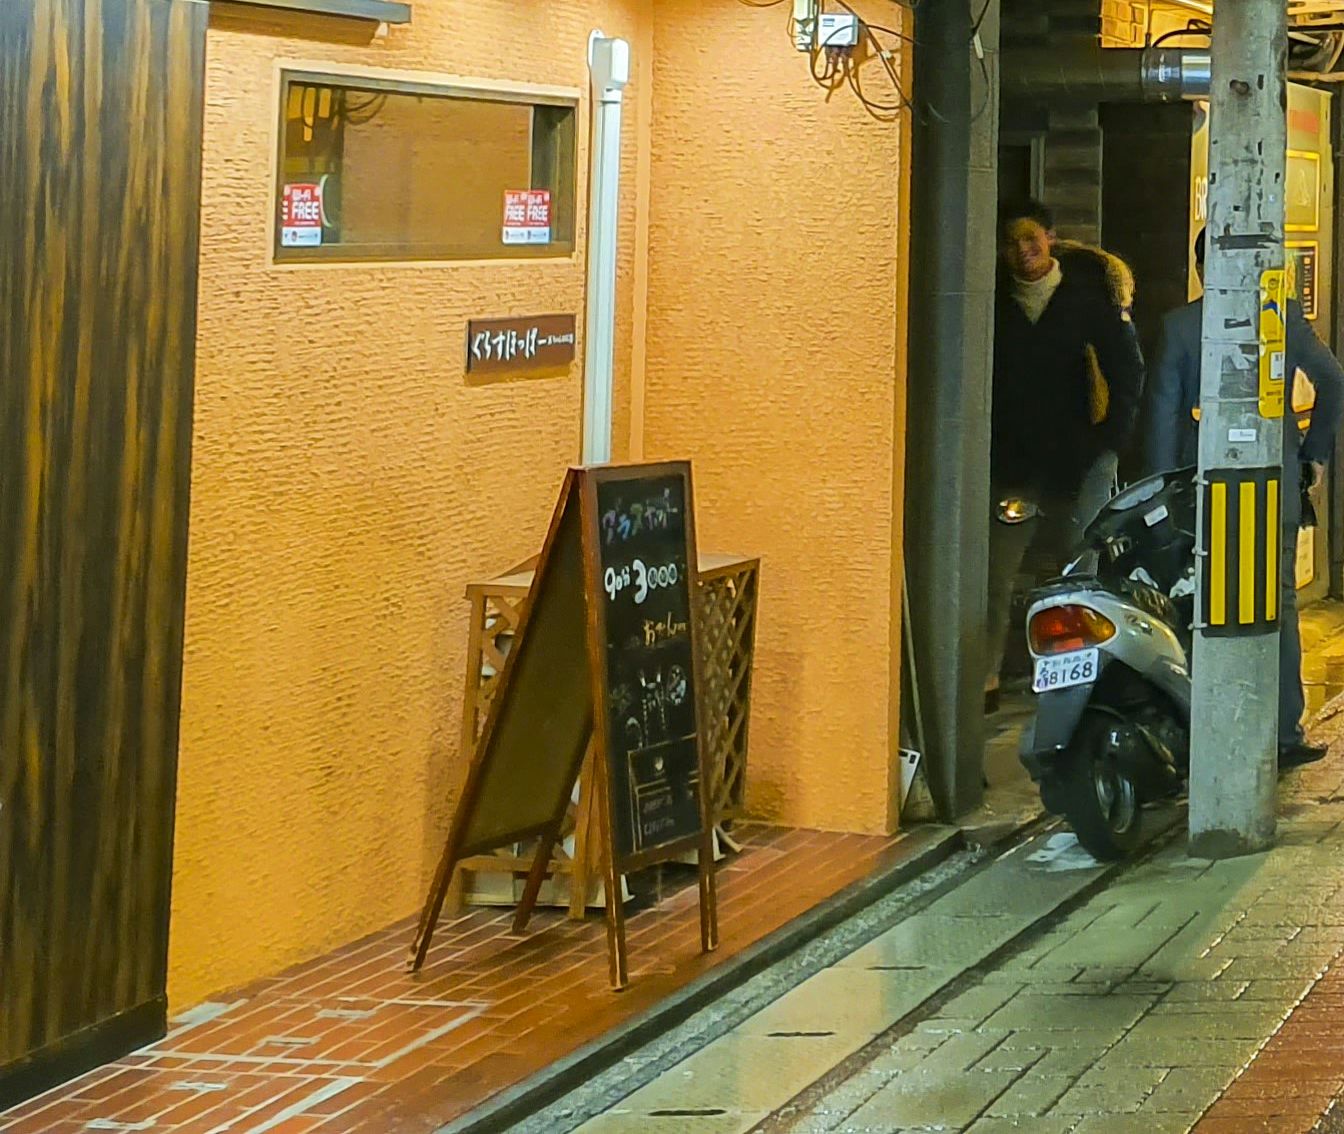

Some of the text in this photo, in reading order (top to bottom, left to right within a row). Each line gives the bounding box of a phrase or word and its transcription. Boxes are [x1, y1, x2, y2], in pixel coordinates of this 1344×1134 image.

[292, 201, 319, 219] FREE
[472, 328, 547, 360] ぐらすほっぱー
[1049, 661, 1092, 684] 8168
